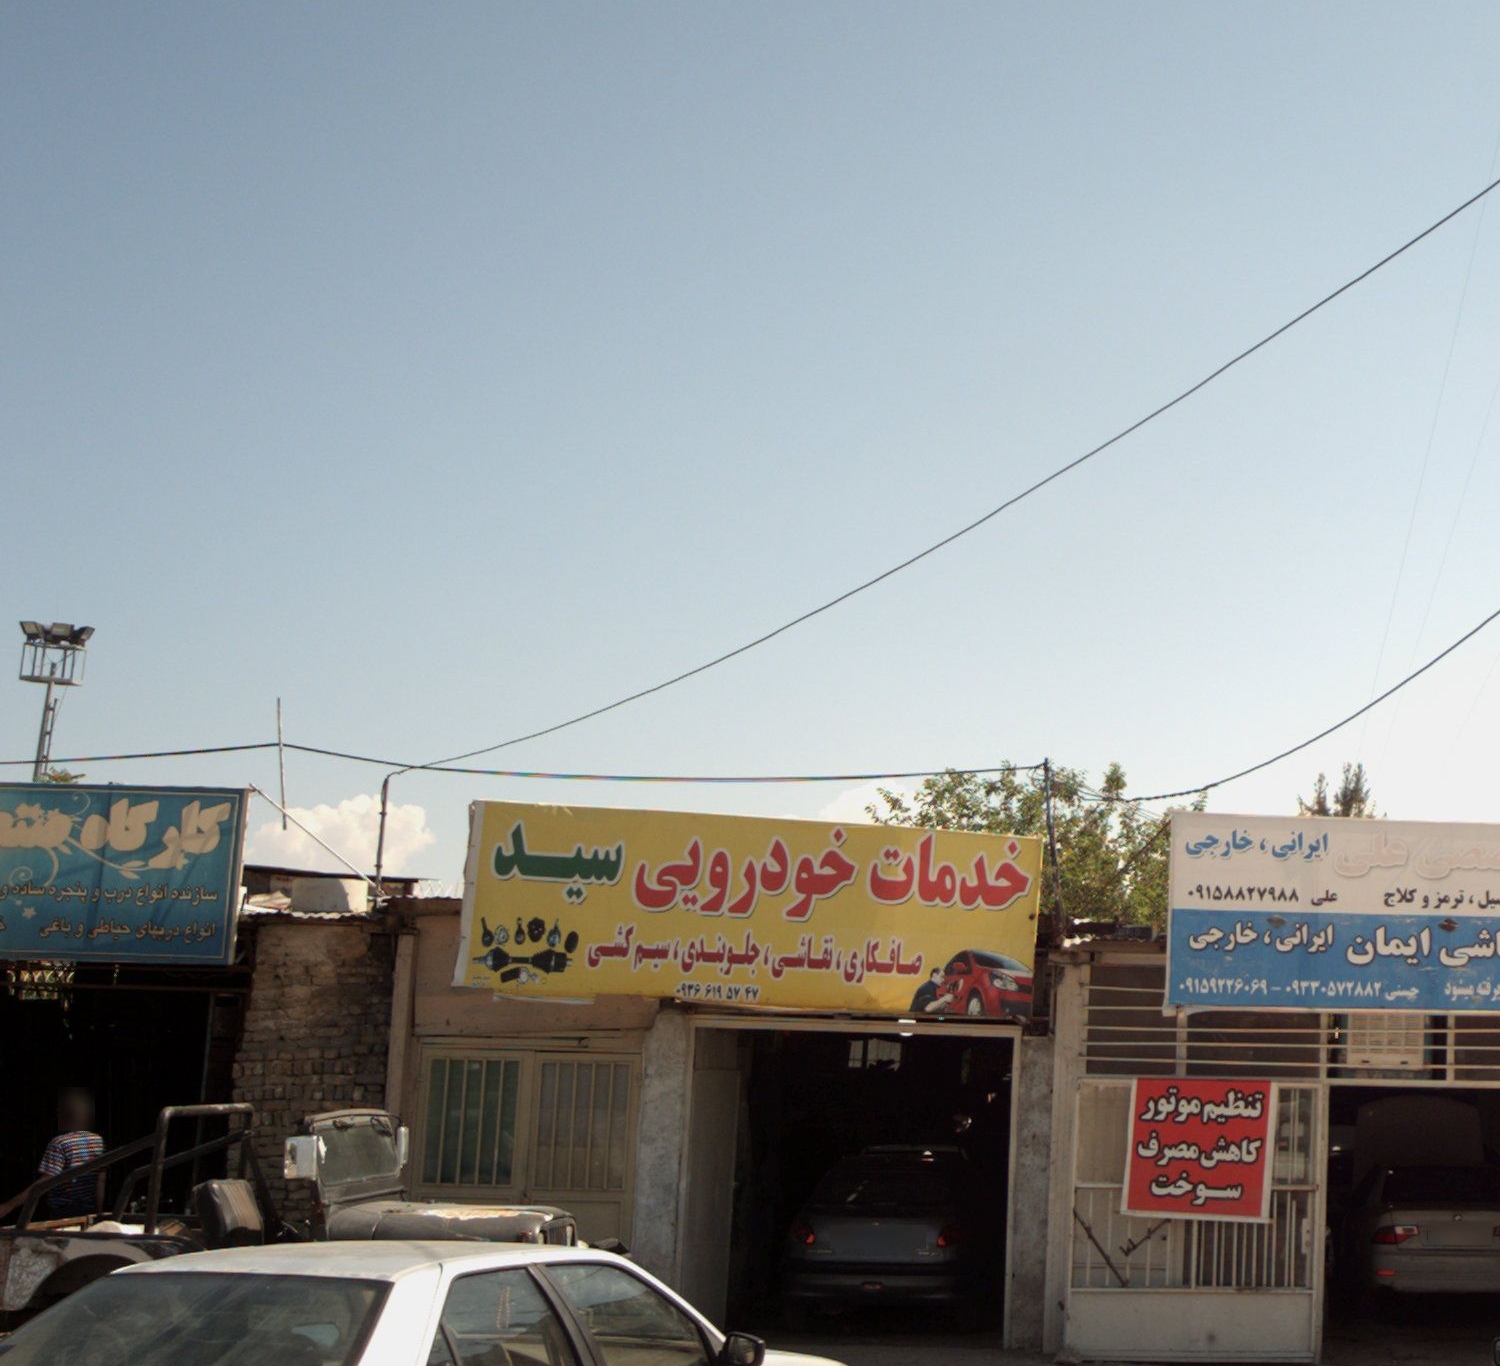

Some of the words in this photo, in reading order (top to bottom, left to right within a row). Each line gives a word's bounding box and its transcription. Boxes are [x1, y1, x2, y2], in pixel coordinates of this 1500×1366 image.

[493, 821, 623, 899] سید
[1185, 828, 1254, 860] خارجی
[870, 833, 1031, 907] خدمات
[91, 886, 100, 903] و
[135, 882, 169, 906] انواع
[1310, 890, 1338, 907] علی
[1422, 893, 1430, 909] و
[1433, 889, 1465, 910] ترمز
[587, 925, 635, 969] کشی
[1188, 921, 1259, 952] خارجی
[1345, 926, 1433, 967] ایمان
[633, 939, 670, 971] سیم
[1139, 1086, 1202, 1123] موتور
[1202, 1090, 1264, 1124] تنظیم
[1136, 1131, 1200, 1167] مصرف
[1199, 1137, 1263, 1169] کاهش
[1149, 1171, 1243, 1207] سوخت
